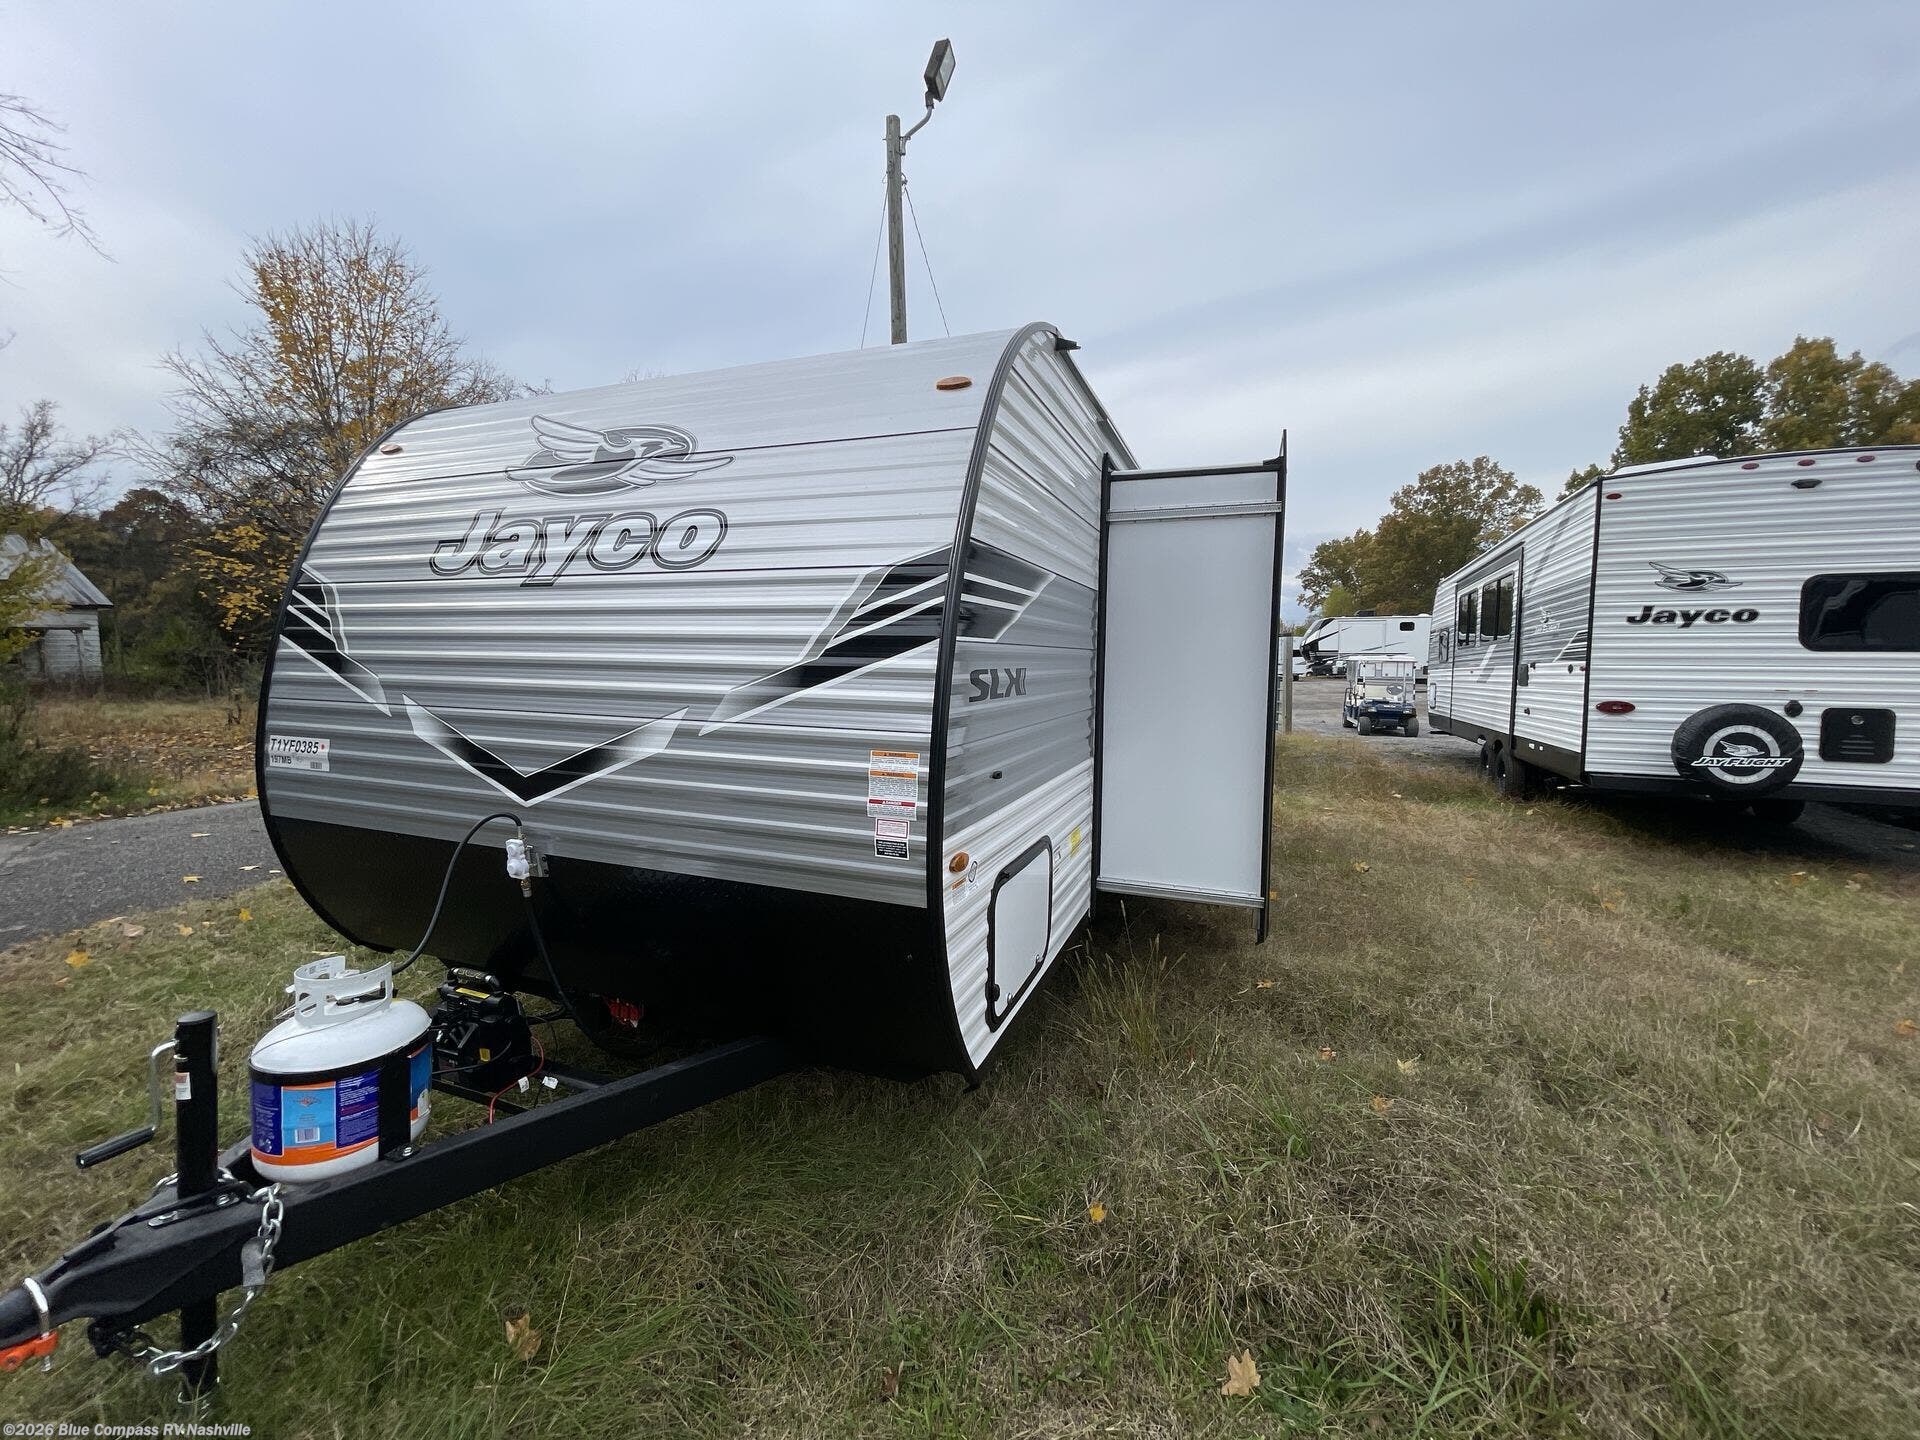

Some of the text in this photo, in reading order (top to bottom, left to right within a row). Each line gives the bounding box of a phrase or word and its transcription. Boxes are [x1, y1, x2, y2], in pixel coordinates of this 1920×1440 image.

[429, 507, 729, 587] Jayco
[1626, 605, 1760, 629] Jayco
[968, 667, 1027, 703] SLX
[271, 738, 319, 754] T1YF0385
